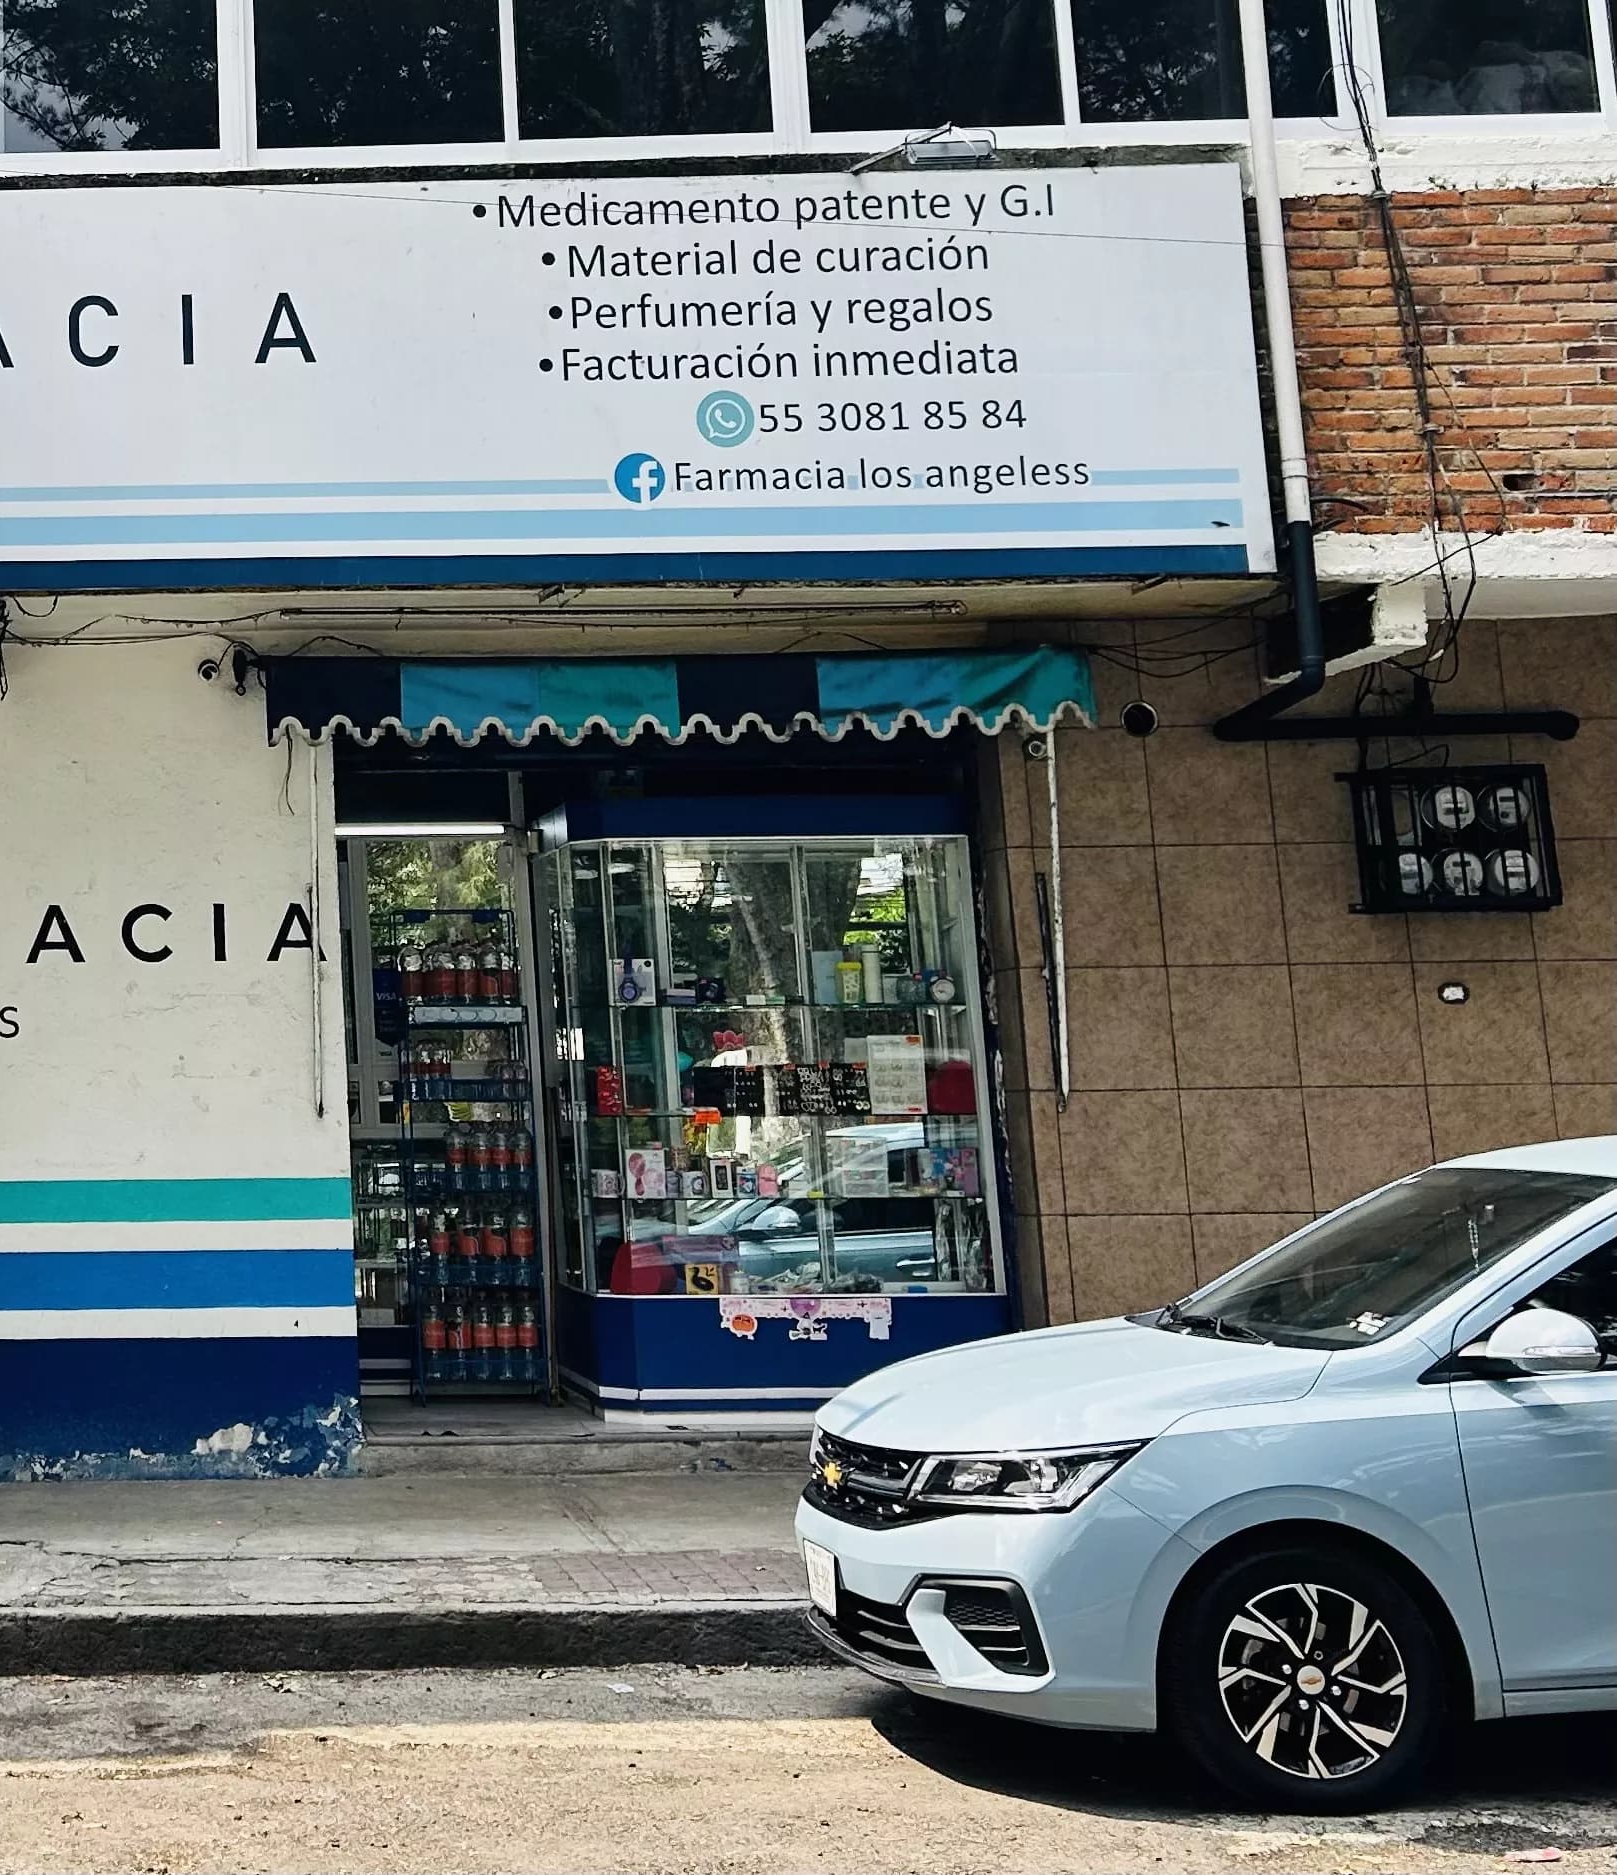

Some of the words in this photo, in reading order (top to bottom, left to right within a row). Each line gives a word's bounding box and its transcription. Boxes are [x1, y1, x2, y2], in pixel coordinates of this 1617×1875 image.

[498, 191, 780, 228] Medicamento
[795, 189, 951, 230] patente
[964, 193, 986, 227] y
[1000, 183, 1053, 217] G.I
[568, 239, 737, 278] Material
[753, 239, 801, 274] de
[816, 235, 988, 273] curación
[571, 290, 796, 329] Perfumería
[810, 300, 832, 334] y
[847, 287, 993, 332] regalos
[562, 342, 798, 381] Facturación
[813, 339, 1018, 377] inmediata
[760, 403, 803, 433] 55
[817, 401, 910, 432] 3081
[924, 401, 967, 430] 85
[982, 399, 1027, 429] 84
[675, 460, 845, 491] Farmacia
[860, 458, 912, 489] los
[926, 455, 1089, 493] angeless
